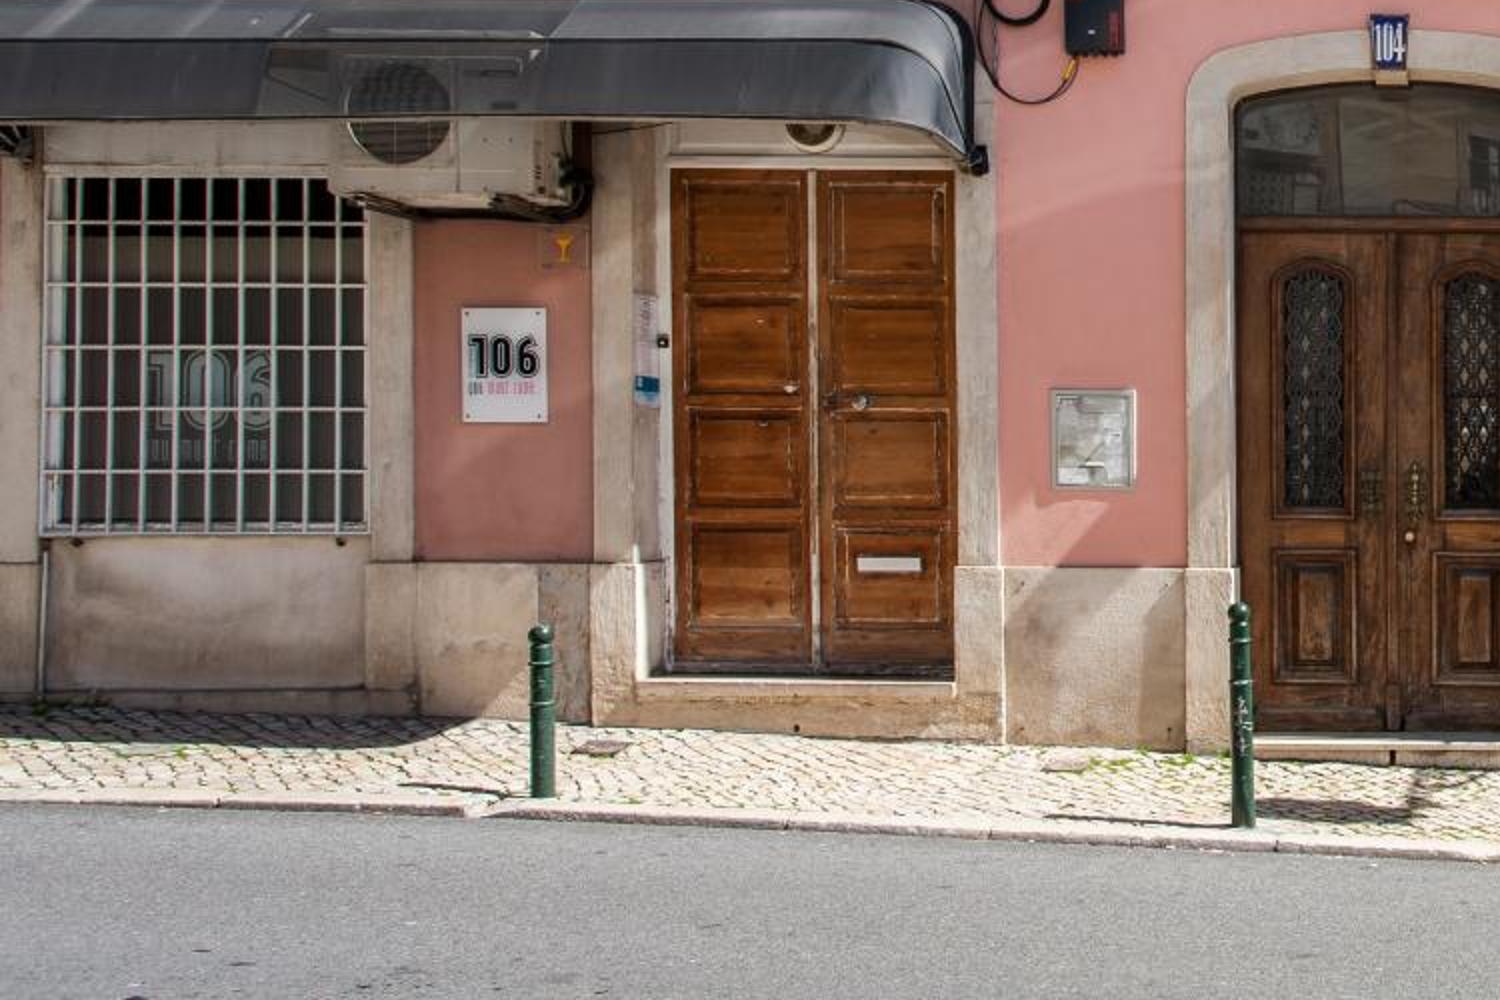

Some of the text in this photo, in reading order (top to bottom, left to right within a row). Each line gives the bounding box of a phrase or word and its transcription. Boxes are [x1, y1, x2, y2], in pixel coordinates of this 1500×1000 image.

[1375, 21, 1406, 62] 104
[468, 334, 541, 379] 106
[145, 347, 274, 431] 106
